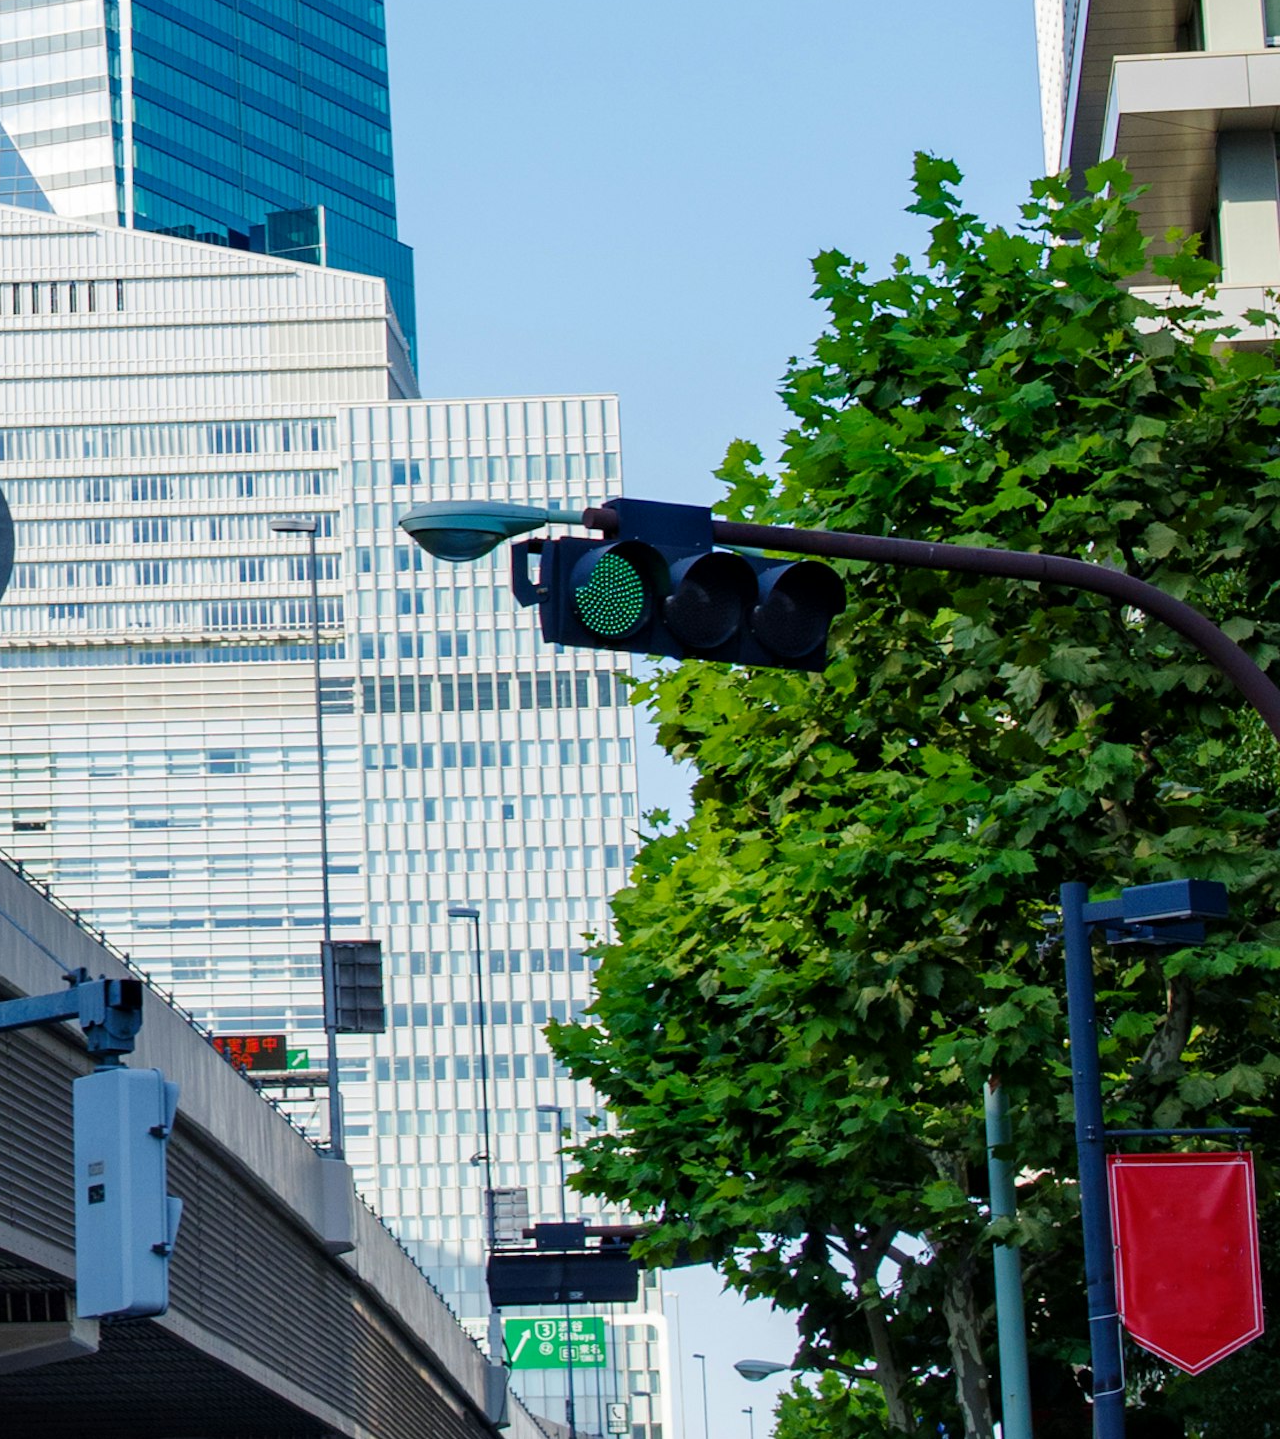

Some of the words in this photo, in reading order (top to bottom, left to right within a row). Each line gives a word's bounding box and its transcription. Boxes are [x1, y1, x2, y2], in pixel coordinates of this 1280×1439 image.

[541, 1324, 551, 1337] 3
[558, 1321, 583, 1332] 渋谷
[558, 1332, 596, 1342] Shibuya
